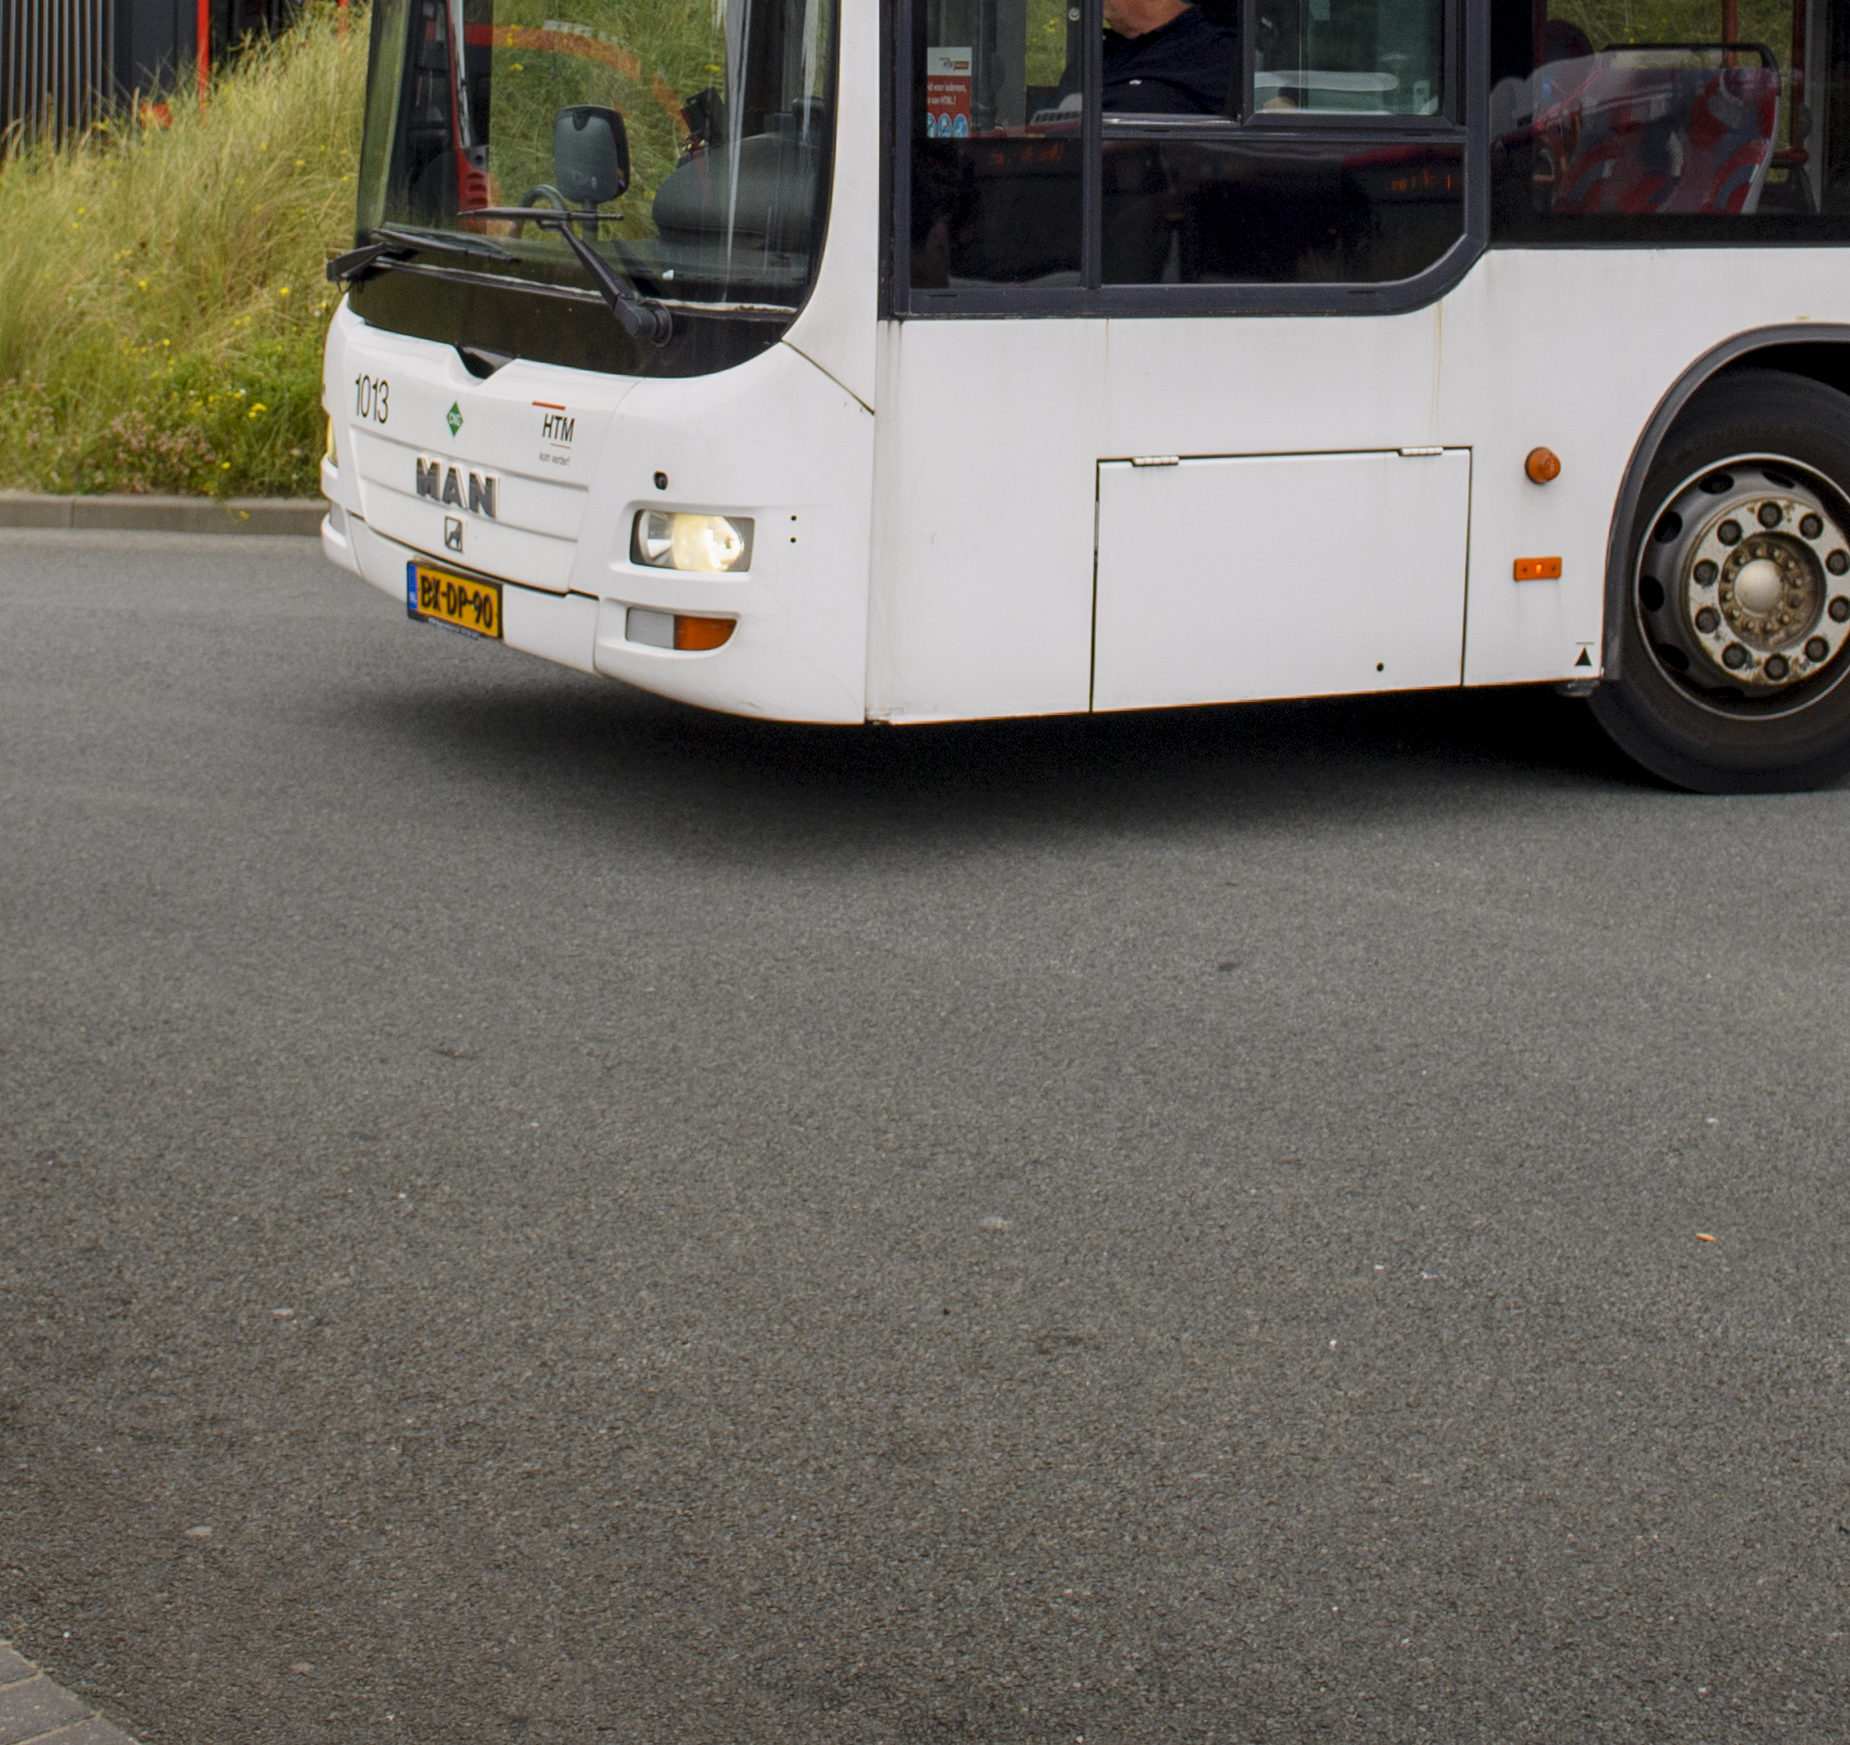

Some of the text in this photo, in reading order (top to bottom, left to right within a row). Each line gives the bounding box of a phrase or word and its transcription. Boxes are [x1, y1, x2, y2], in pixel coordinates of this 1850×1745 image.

[354, 372, 390, 425] 1013
[541, 413, 576, 443] HTM
[415, 456, 498, 519] MAN
[420, 574, 493, 629] BX-DP-90
